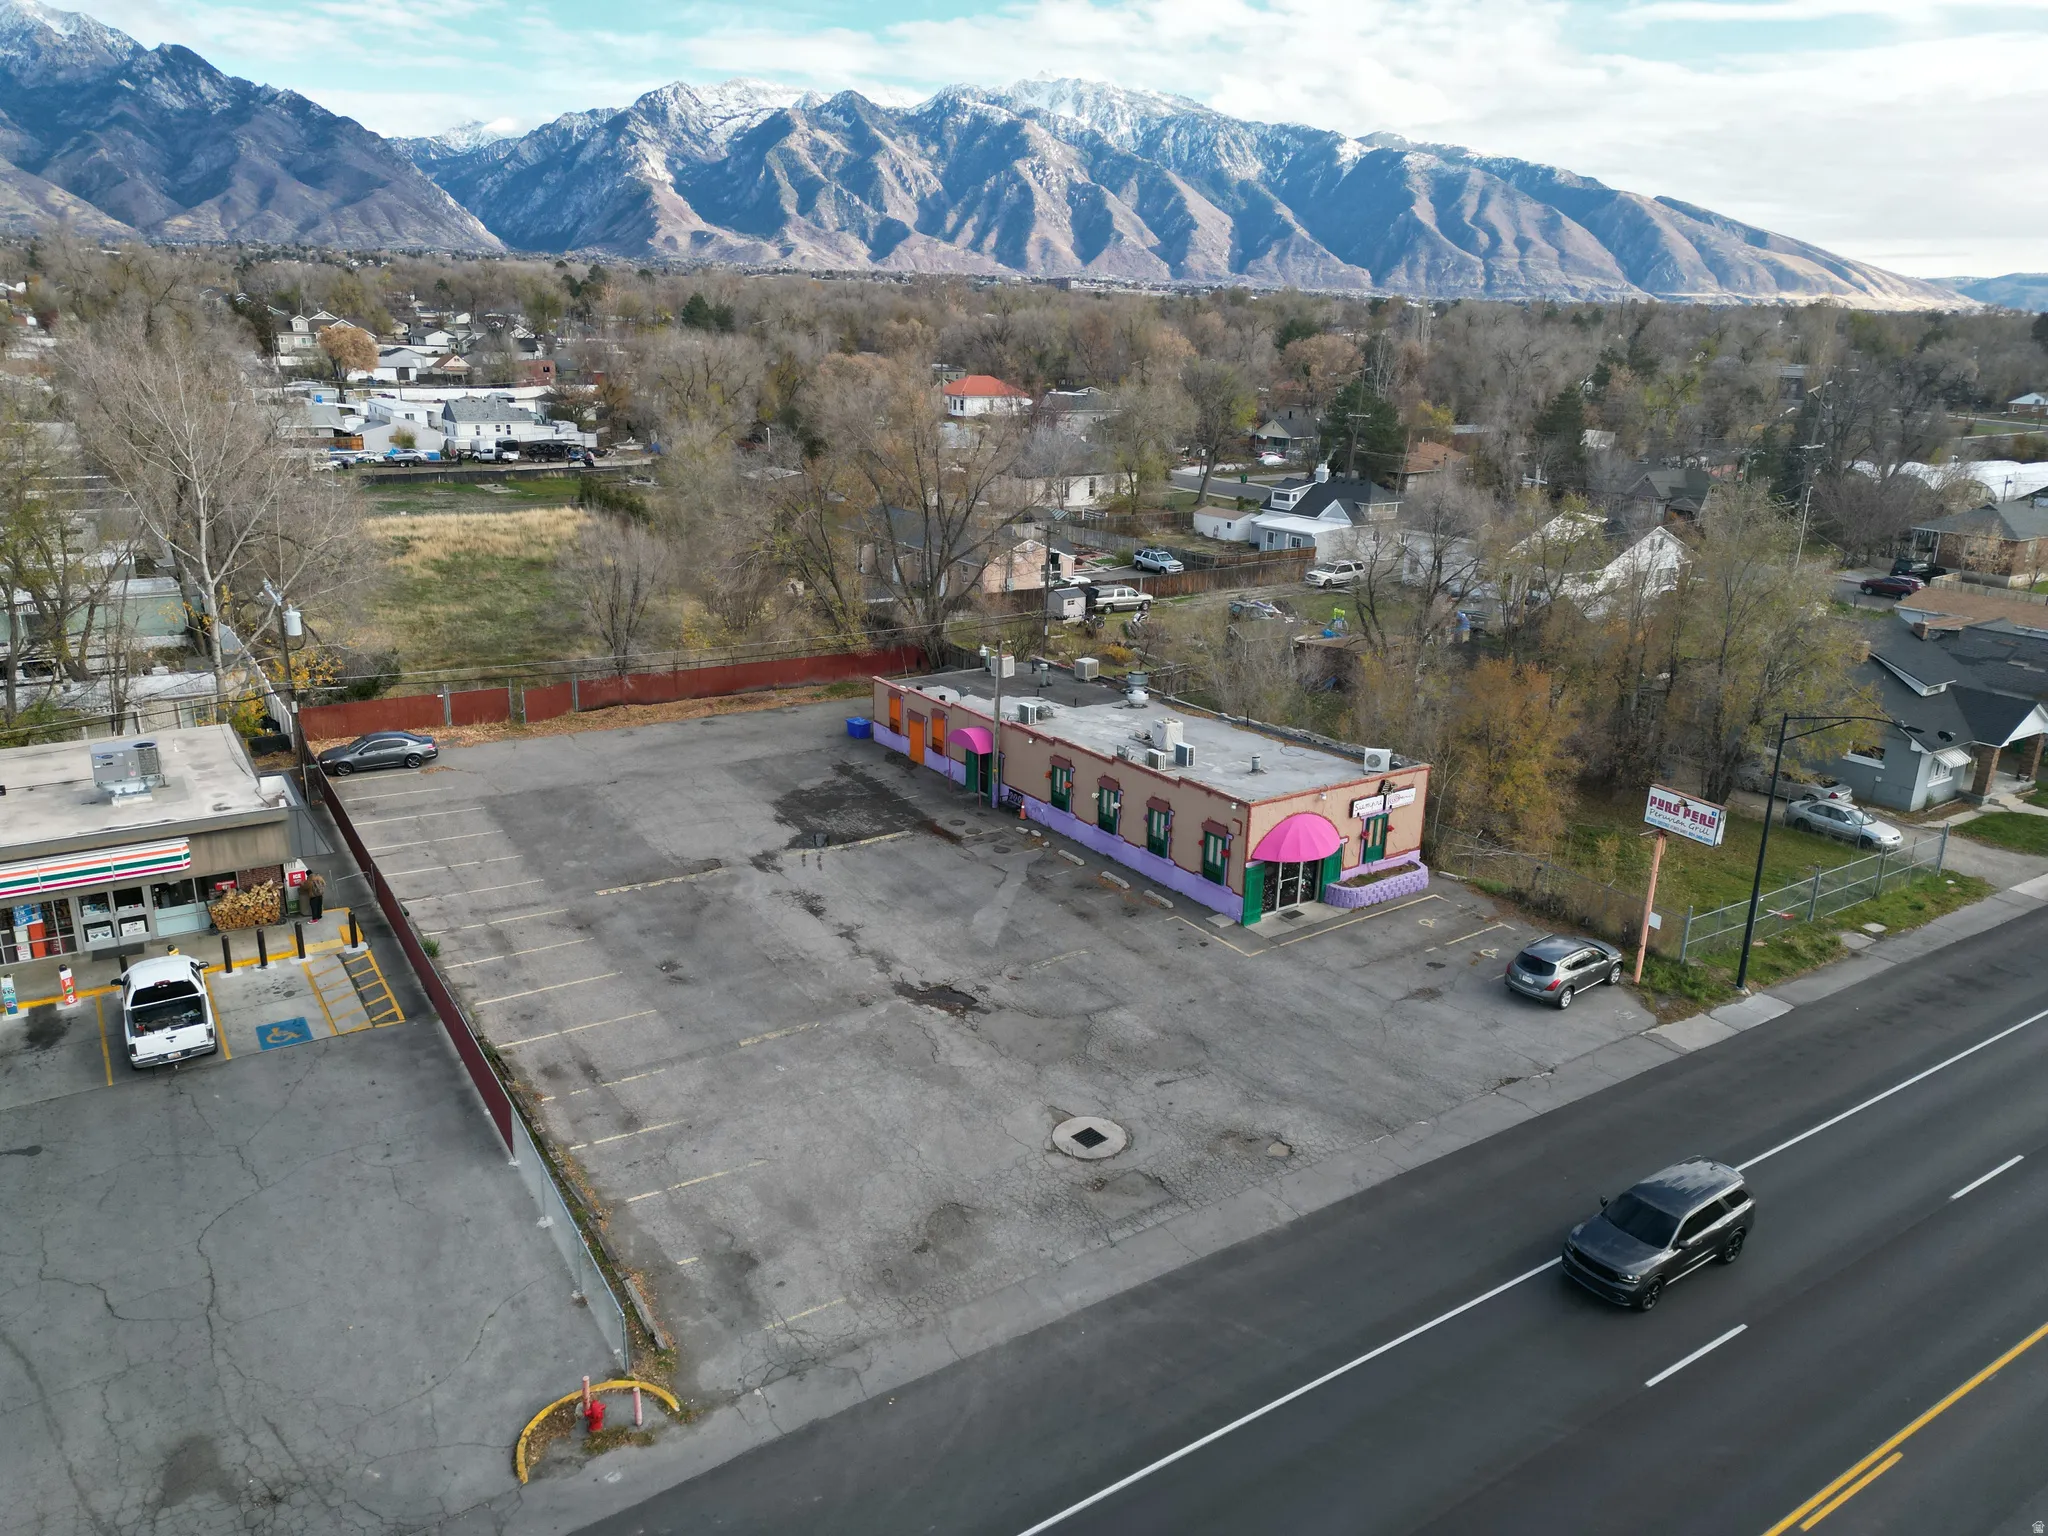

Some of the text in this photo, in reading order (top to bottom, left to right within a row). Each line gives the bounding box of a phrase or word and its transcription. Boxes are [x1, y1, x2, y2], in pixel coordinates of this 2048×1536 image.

[1649, 809, 1686, 827] Peruvian
[1688, 823, 1709, 836] Grill
[1683, 807, 1715, 828] PERU
